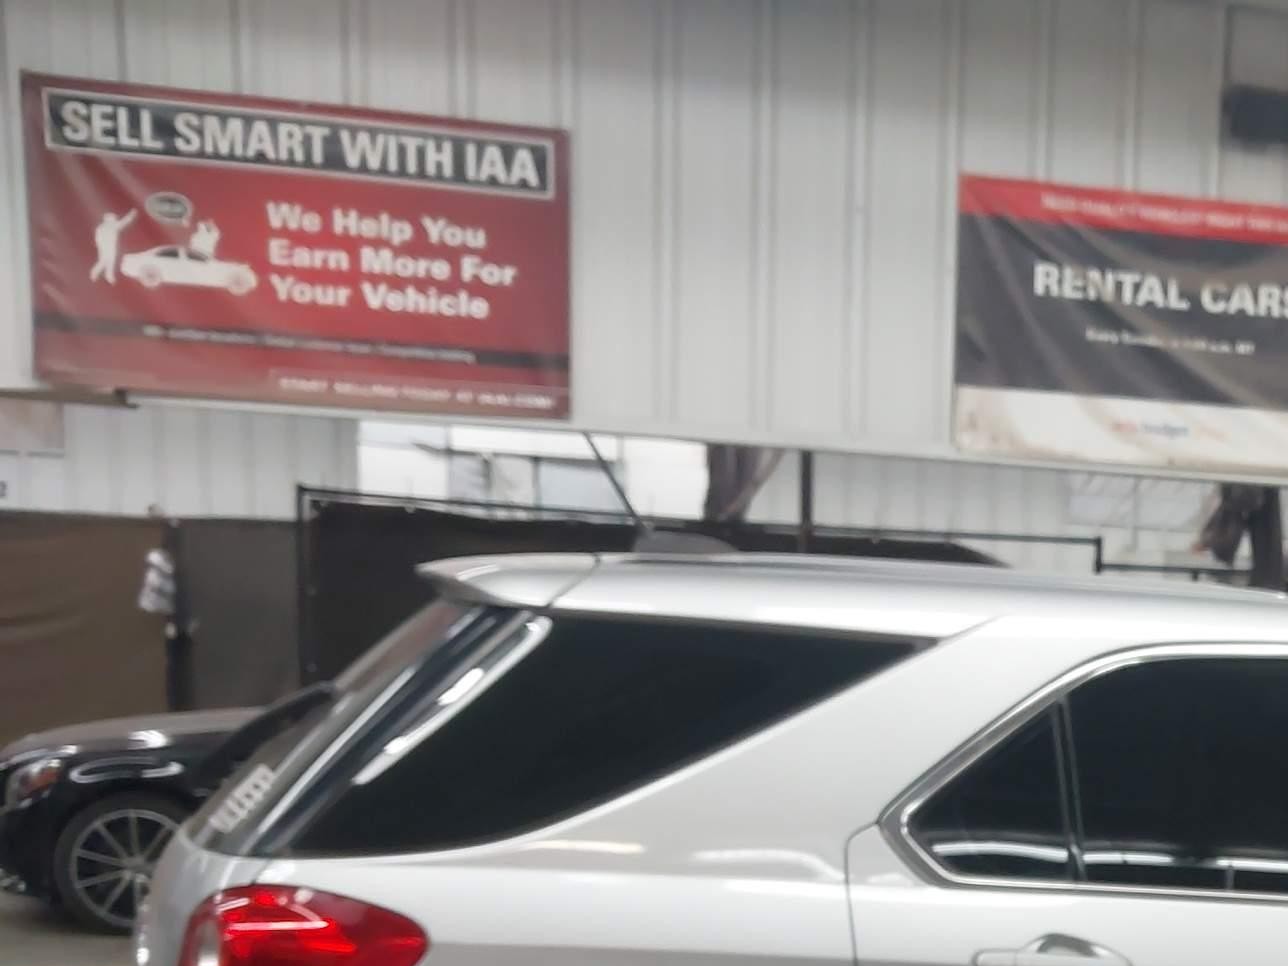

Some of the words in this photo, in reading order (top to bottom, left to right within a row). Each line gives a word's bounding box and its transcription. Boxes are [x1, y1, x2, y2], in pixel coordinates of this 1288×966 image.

[60, 100, 164, 150] SELL
[173, 111, 330, 165] SMART
[338, 128, 454, 179] WITH
[464, 142, 540, 187] IAA
[266, 201, 322, 233] We
[332, 207, 414, 246] Help
[420, 214, 487, 249] You
[268, 237, 350, 271] Earn
[359, 246, 452, 281] More
[460, 254, 518, 287] For
[1033, 261, 1192, 312] RENTAL
[269, 273, 352, 307] Your
[360, 281, 490, 319] Vehicle
